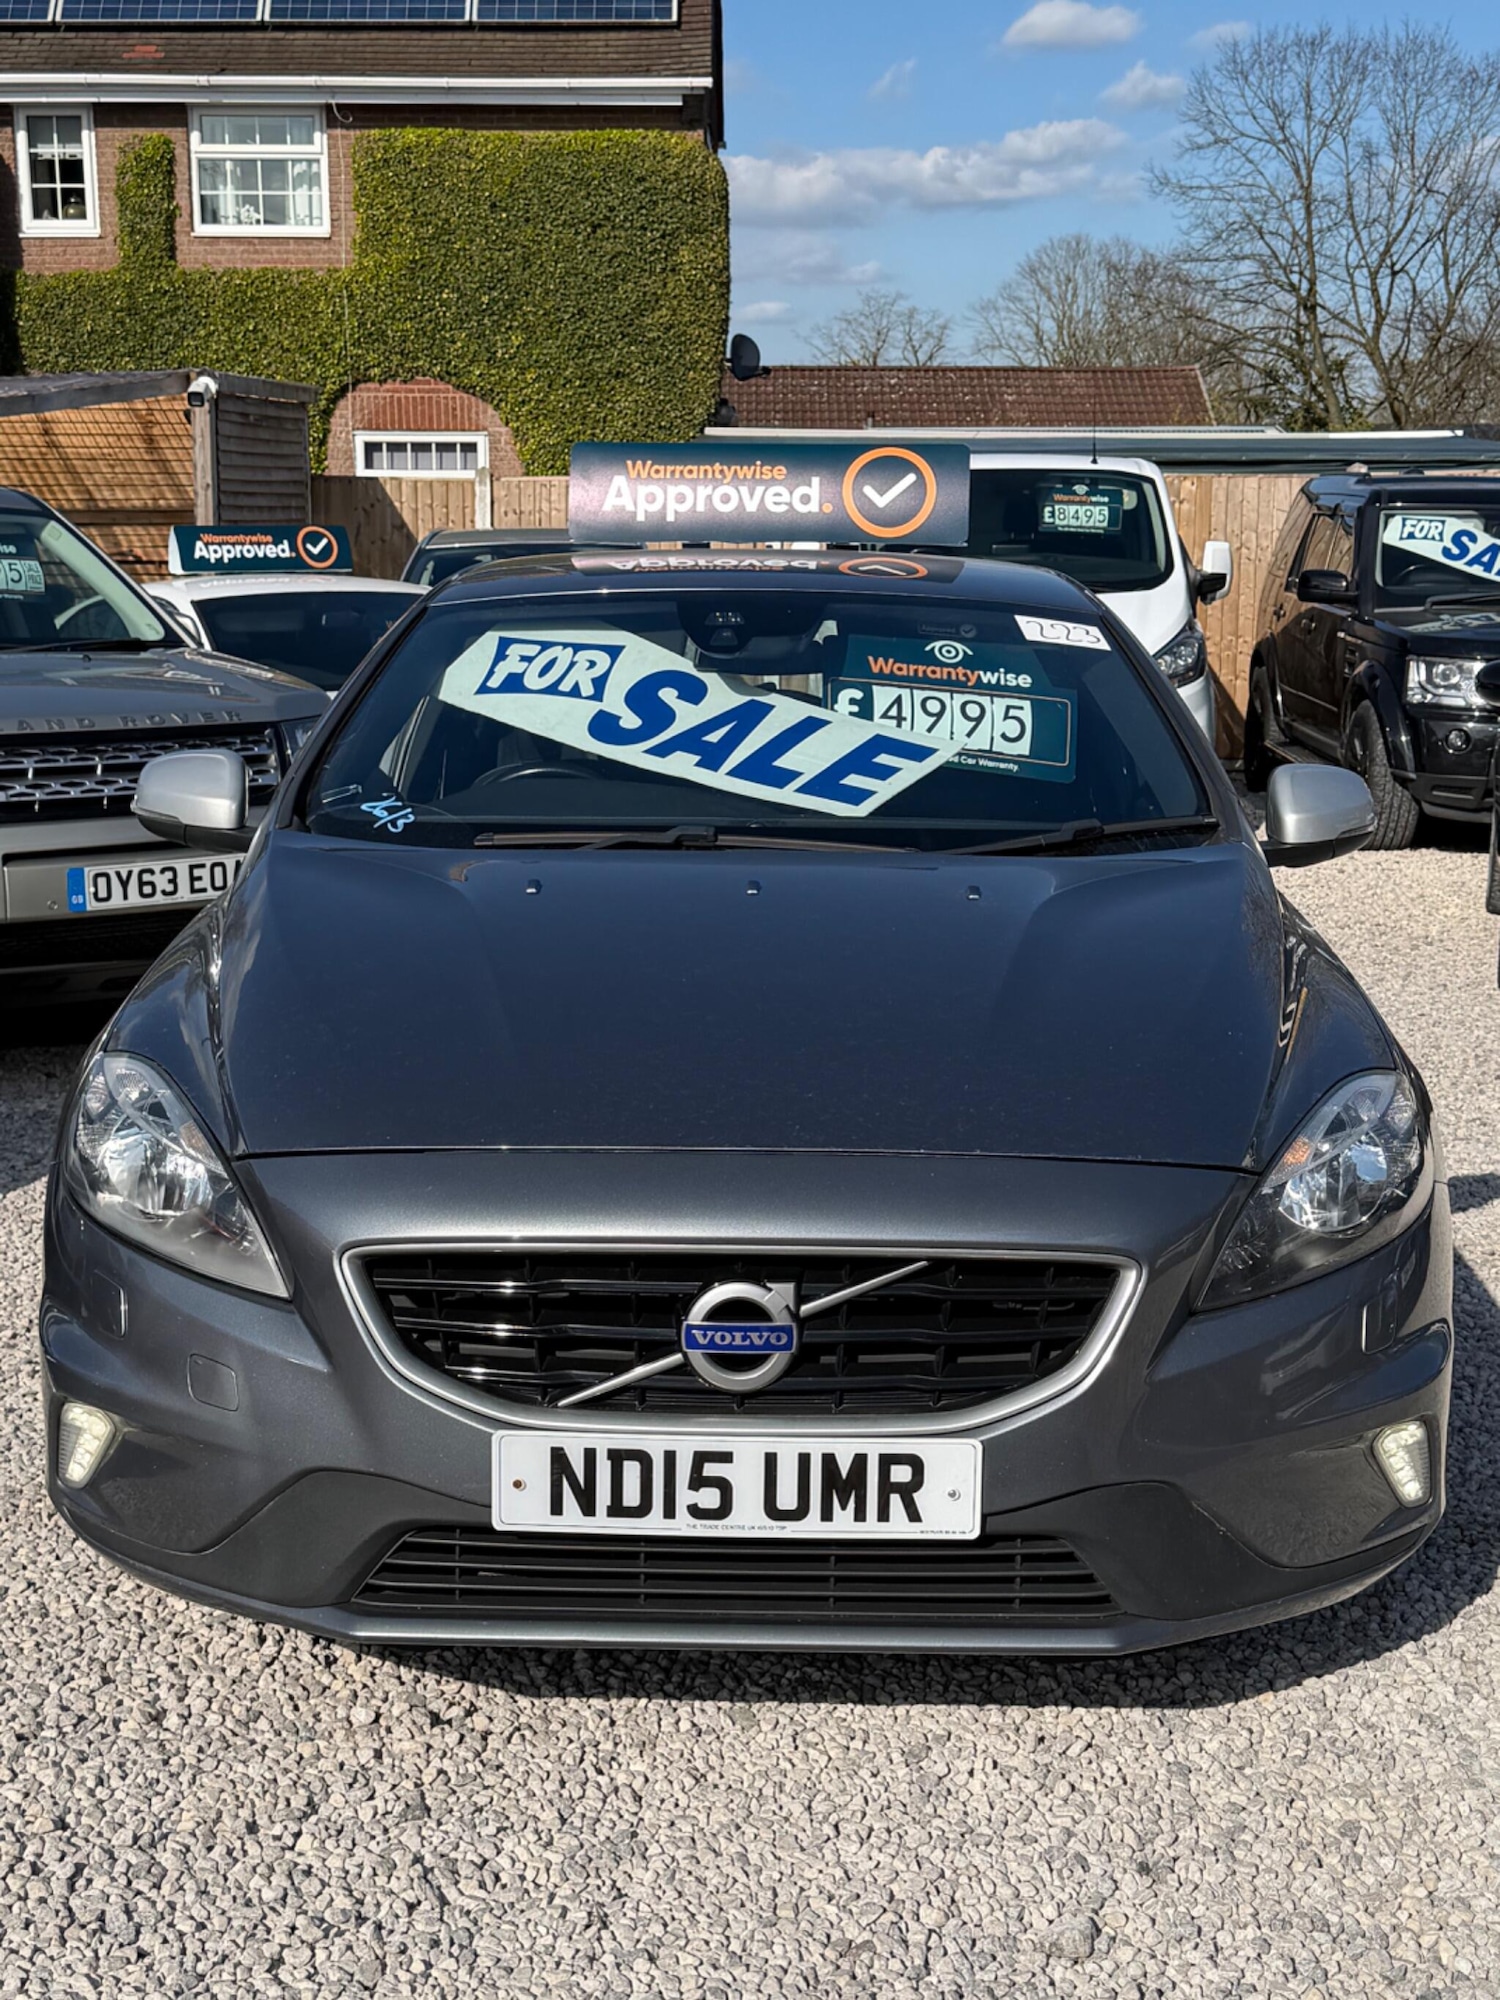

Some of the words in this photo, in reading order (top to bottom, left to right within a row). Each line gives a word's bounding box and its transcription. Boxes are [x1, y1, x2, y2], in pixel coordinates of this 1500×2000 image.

[626, 460, 787, 484] Warrantywise
[601, 475, 833, 522] Approved.
[1043, 506, 1107, 524] £8495
[200, 533, 273, 545] Warrantywise
[1401, 518, 1444, 542] FOR
[194, 539, 296, 563] Approved.
[1441, 529, 1500, 575] SA
[1026, 620, 1101, 644] 223
[485, 642, 612, 698] FOR
[868, 655, 1032, 688] Warrantywise
[0, 718, 96, 731] AND
[118, 710, 243, 728] ROVER
[833, 688, 1026, 743] £4995
[587, 669, 941, 807] SALE
[960, 755, 976, 765] Car
[92, 866, 179, 903] OY63
[691, 1329, 788, 1347] VOLVO
[549, 1445, 734, 1521] ND15
[764, 1451, 925, 1523] UMR
